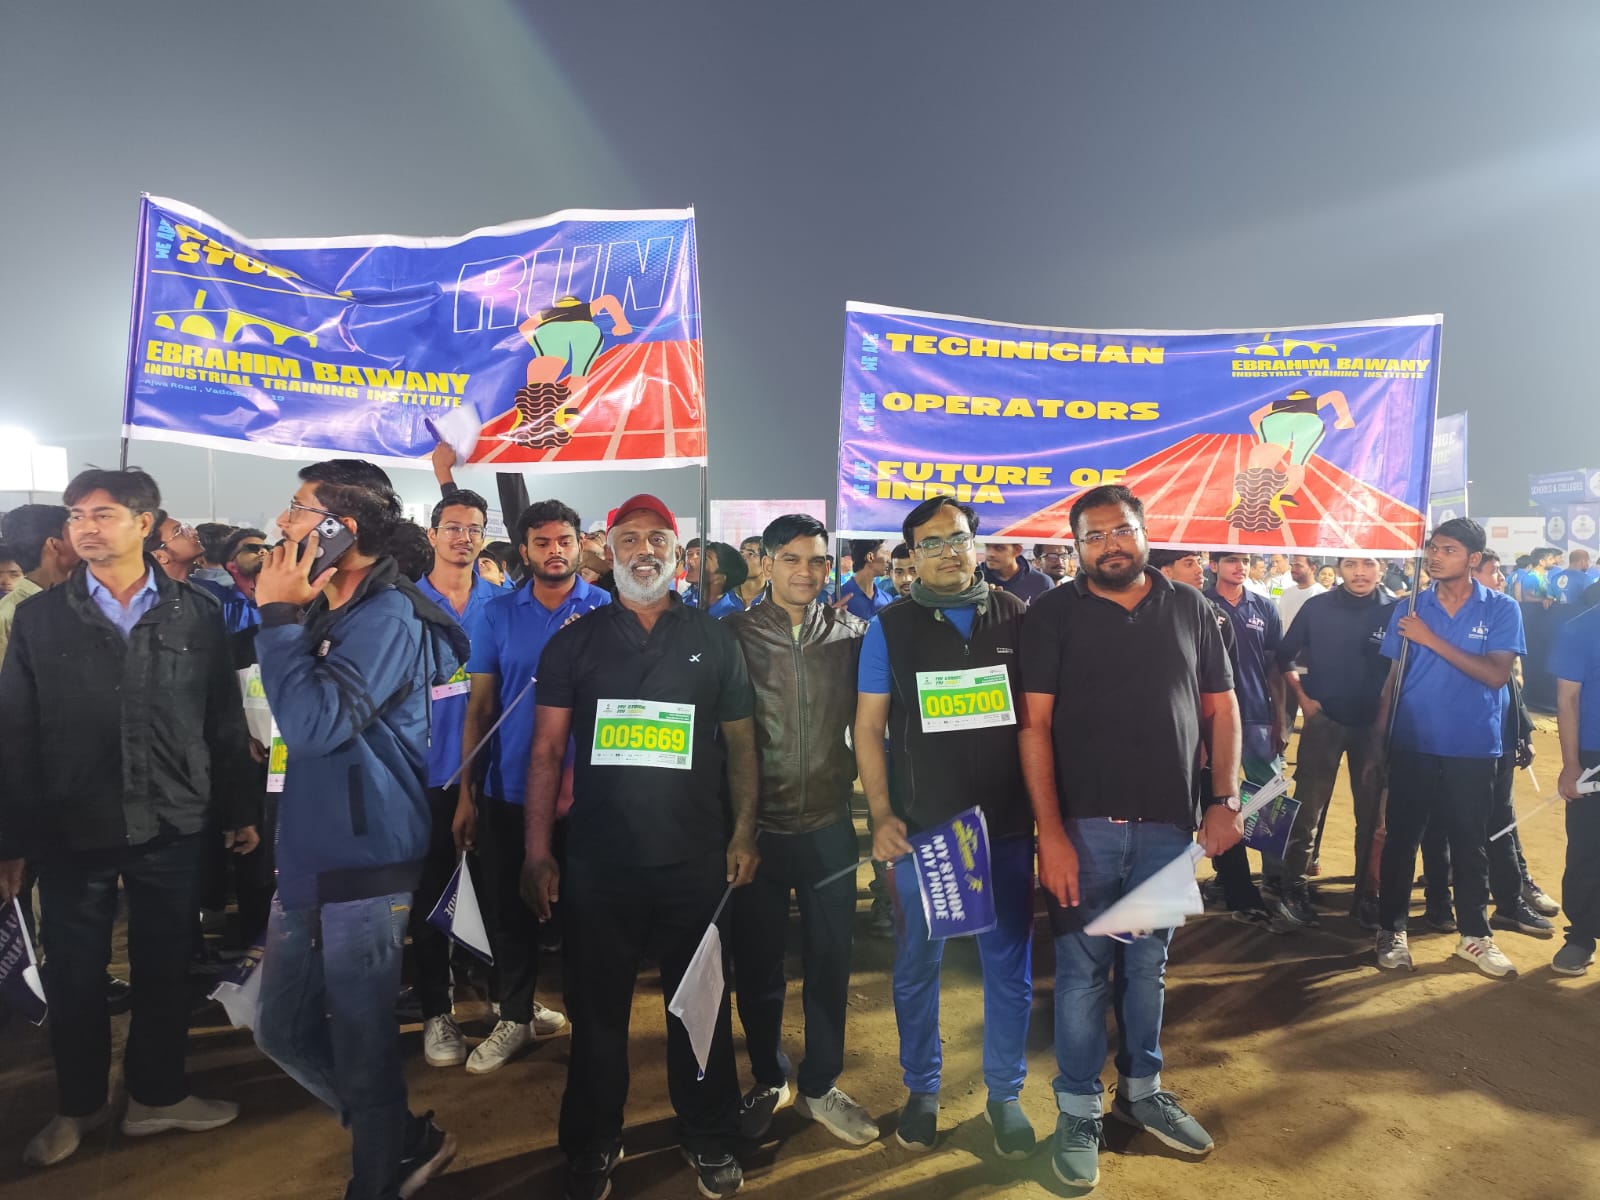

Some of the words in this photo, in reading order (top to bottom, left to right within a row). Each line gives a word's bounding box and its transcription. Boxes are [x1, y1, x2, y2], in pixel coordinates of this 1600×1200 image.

[453, 236, 674, 333] RUN
[886, 333, 1165, 365] TECHNICIAN
[147, 340, 301, 379] EBRAHIM
[312, 361, 471, 395] BAWANY
[861, 356, 878, 371] WE
[1232, 359, 1330, 371] EBRAHIM
[1337, 358, 1431, 372] BAWANY
[1363, 371, 1425, 379] INSTITUTE
[144, 362, 253, 387] INDUSTRIAL
[261, 377, 358, 399] TRAINING
[367, 389, 463, 408] INSTITUTE
[171, 382, 197, 392] Road
[882, 392, 1160, 421] OPERATORS
[877, 461, 1053, 486] FUTURE
[1069, 468, 1127, 487] OF
[876, 481, 1006, 504] INDIA
[926, 690, 1004, 717] 005700
[601, 724, 685, 752] 005669
[920, 844, 938, 869] MY
[927, 871, 950, 920] PRIDE
